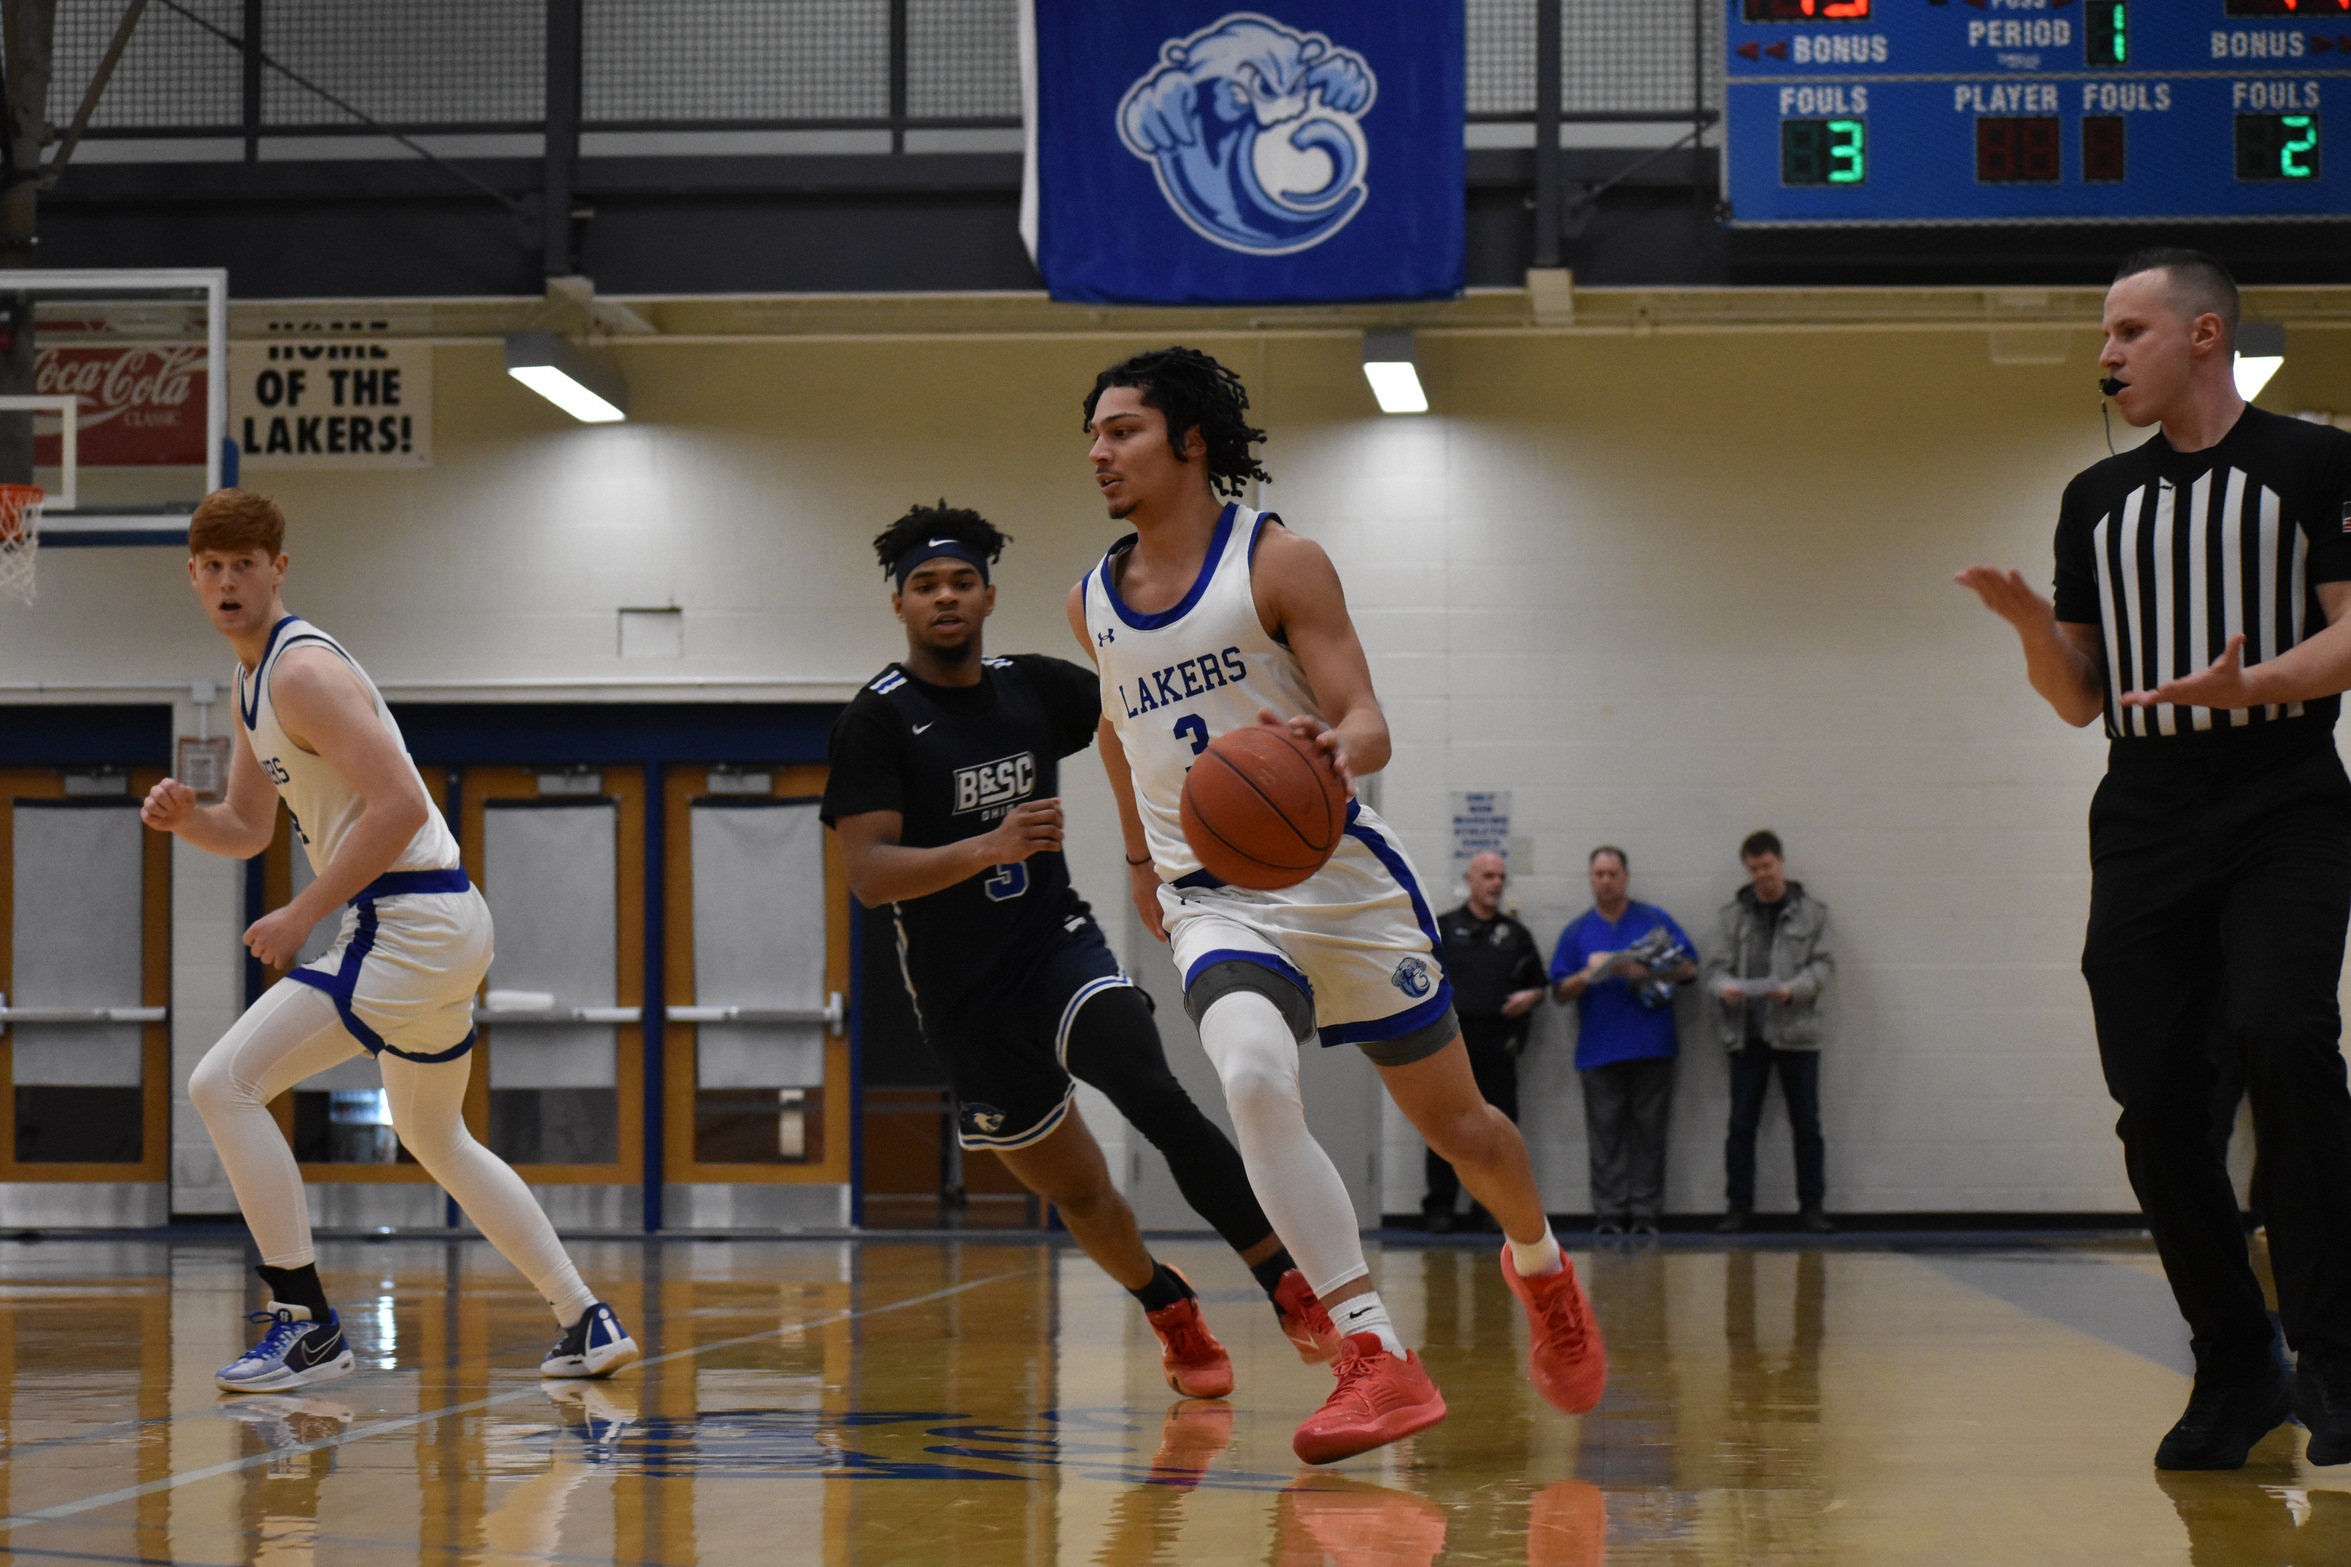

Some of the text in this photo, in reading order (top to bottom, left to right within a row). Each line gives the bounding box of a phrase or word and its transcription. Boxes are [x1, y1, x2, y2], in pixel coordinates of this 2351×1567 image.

[1793, 34, 1888, 64] BONUS
[1968, 18, 2072, 48] PERIOD
[2112, 3, 2127, 63] 1
[2210, 30, 2305, 59] BONUS
[1779, 86, 1869, 115] FOULS
[1954, 82, 2172, 113] PLAYER FOULS
[2232, 81, 2321, 110] FOULS
[1827, 119, 1865, 183] 3
[2281, 115, 2318, 177] 2
[255, 368, 401, 408] OF THE
[243, 415, 413, 455] LAKERS!
[1119, 645, 1247, 719] LAKERS
[956, 754, 1035, 812] B&SC
